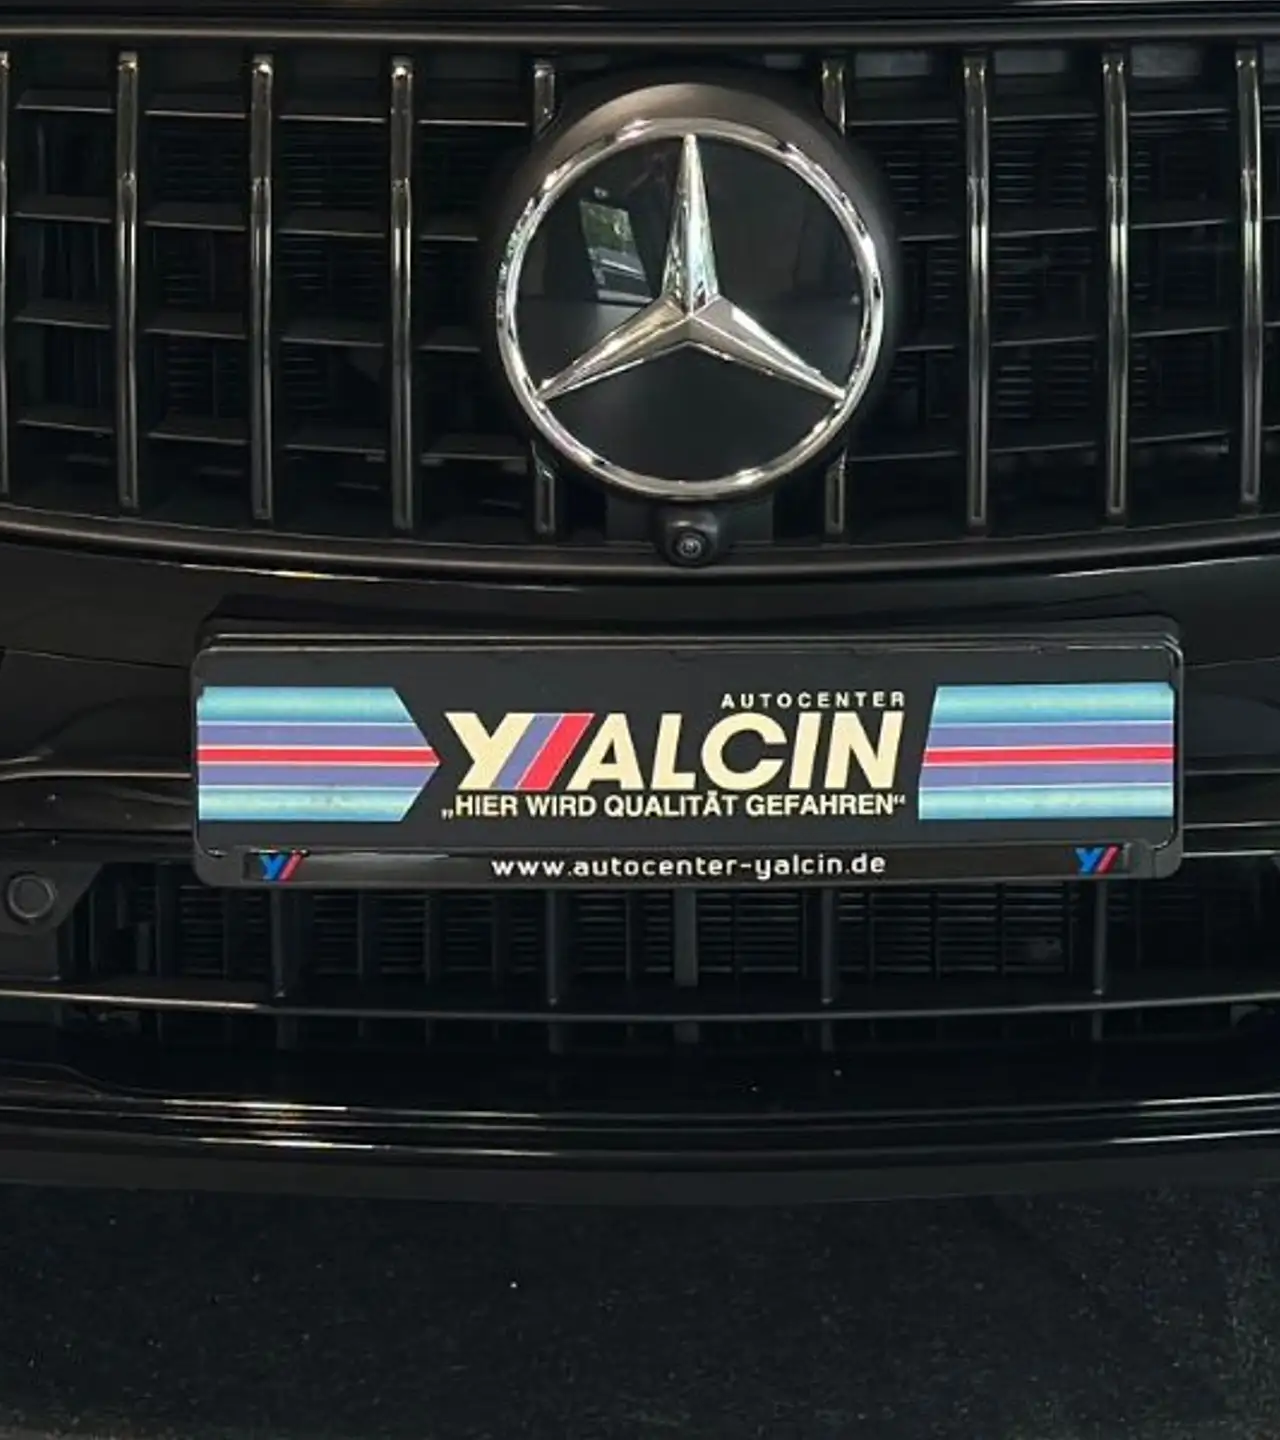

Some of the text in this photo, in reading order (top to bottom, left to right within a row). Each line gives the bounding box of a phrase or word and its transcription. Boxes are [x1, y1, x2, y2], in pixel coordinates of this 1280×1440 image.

[720, 690, 906, 709] AUTOCENTER
[525, 794, 597, 818] WIRD
[603, 790, 739, 818] QUALITÄT
[491, 854, 886, 881] www.autocenter-yalcin.de
